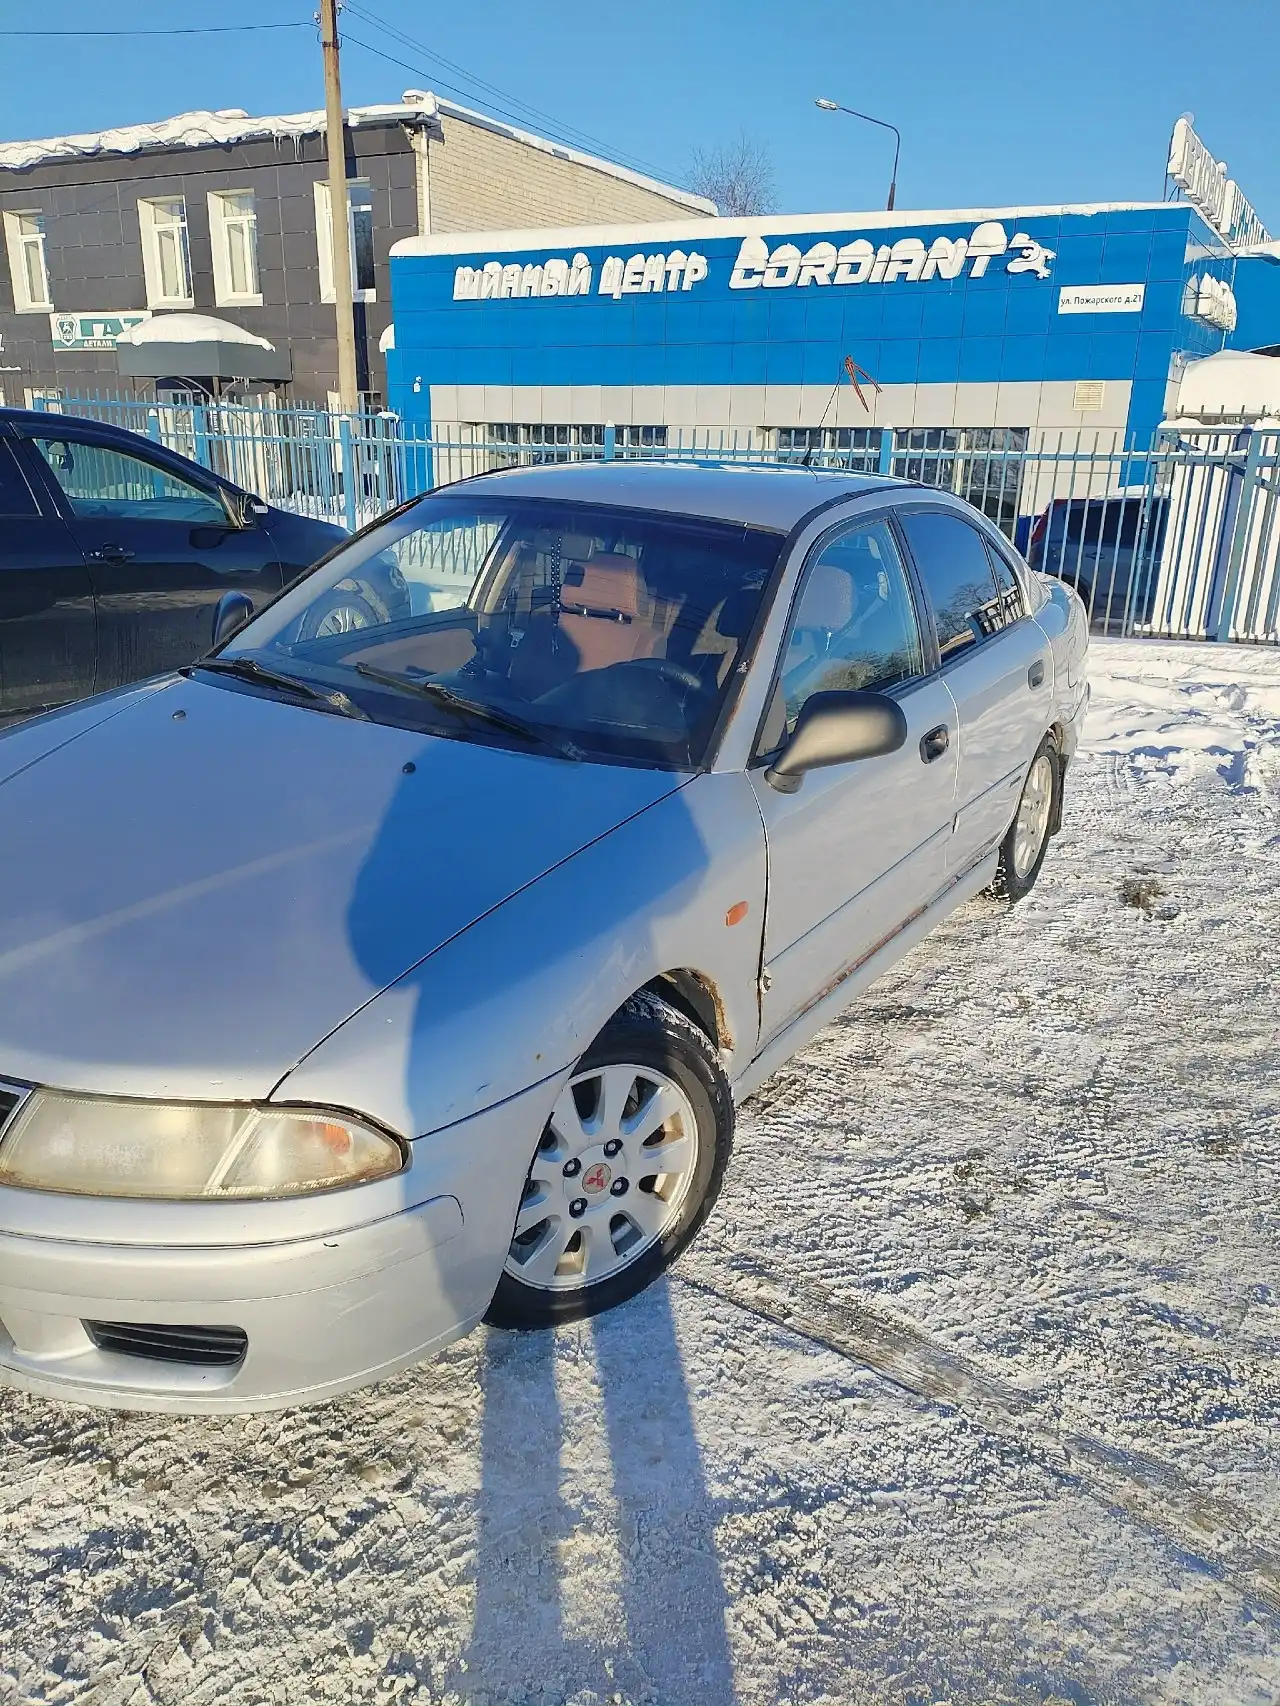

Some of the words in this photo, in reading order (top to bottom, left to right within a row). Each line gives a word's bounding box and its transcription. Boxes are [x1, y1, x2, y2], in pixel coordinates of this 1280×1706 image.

[728, 228, 1008, 290] CORDIANT
[453, 254, 592, 300] ШИННЫЙ
[598, 252, 708, 299] ЦЕНТР
[1060, 298, 1072, 307] ул.
[1074, 296, 1122, 306] Пожарского
[83, 339, 113, 348] ДЕТАЛИ
